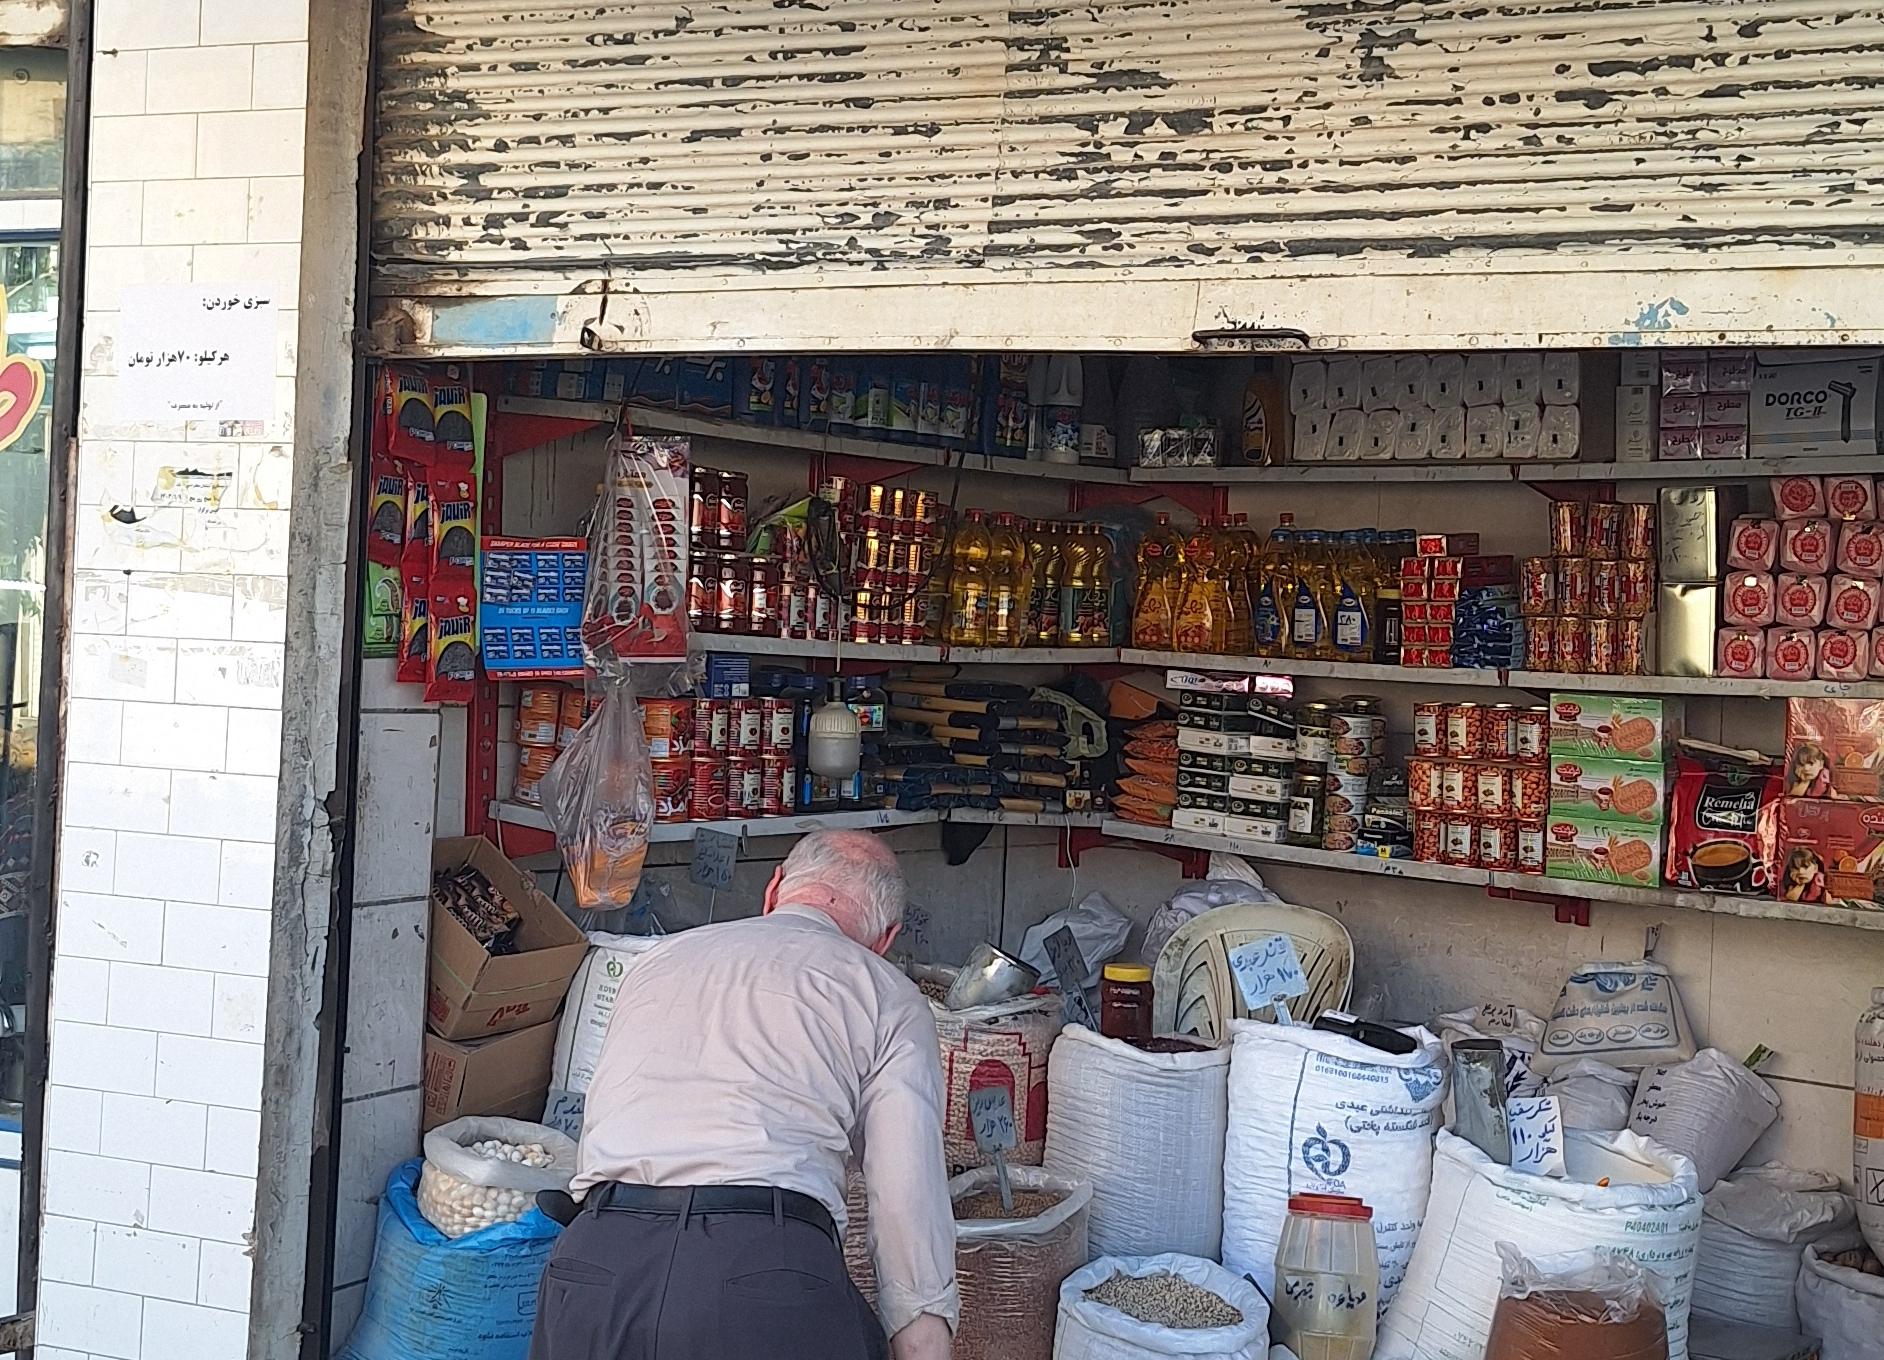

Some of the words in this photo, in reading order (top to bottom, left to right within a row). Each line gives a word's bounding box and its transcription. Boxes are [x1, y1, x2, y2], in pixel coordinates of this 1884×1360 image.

[202, 293, 241, 311] خوردن:
[243, 295, 271, 310] سبزی
[128, 351, 153, 367] تومان
[1717, 399, 1742, 412] مطرح
[1765, 389, 1829, 407] DORCO
[1715, 432, 1741, 445] مطرح
[1250, 969, 1276, 996] هزار
[1517, 1141, 1559, 1164] هزار
